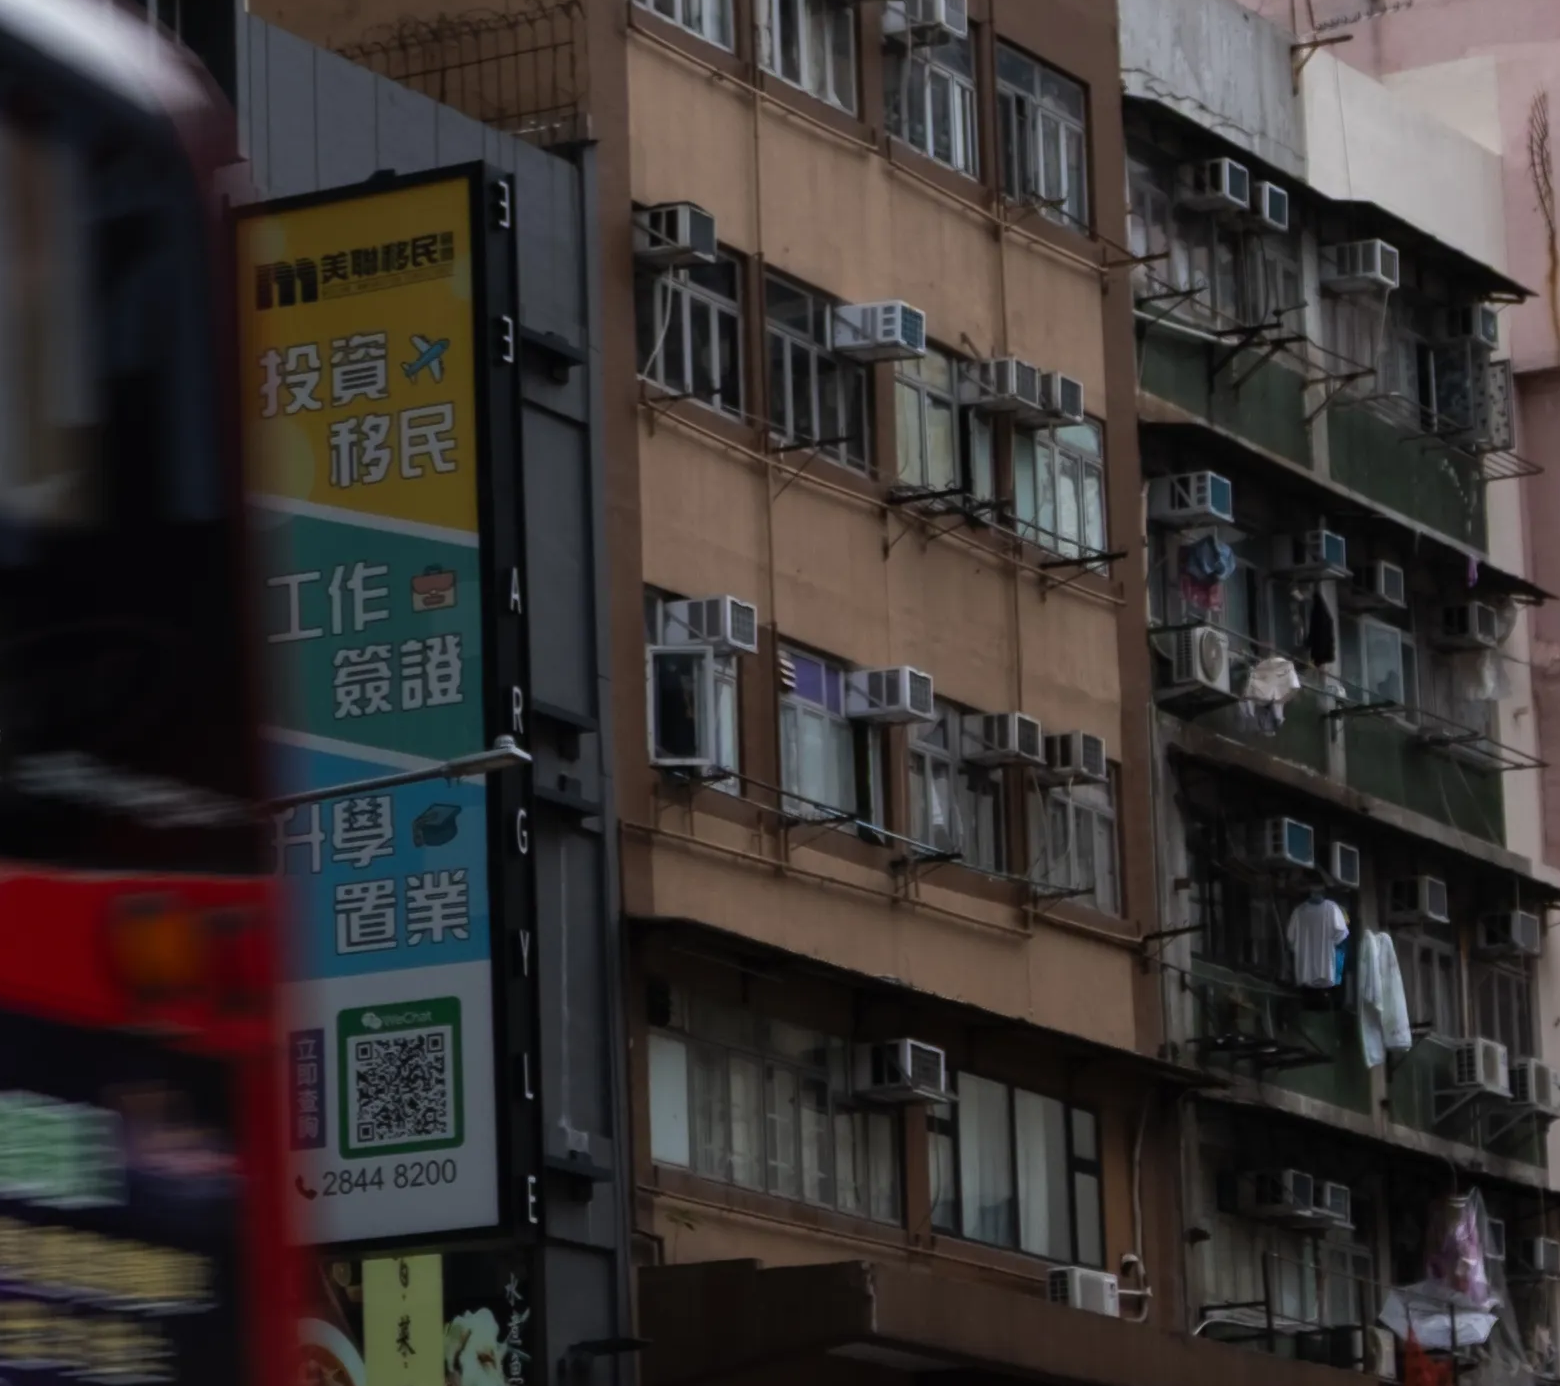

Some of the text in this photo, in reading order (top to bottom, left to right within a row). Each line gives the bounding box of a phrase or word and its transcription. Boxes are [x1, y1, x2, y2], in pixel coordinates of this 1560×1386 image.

[259, 330, 391, 421] 投資
[329, 400, 460, 490] 移民
[265, 561, 391, 646] 工作
[333, 632, 465, 721] 簽證
[333, 867, 472, 958] 置業
[381, 1009, 435, 1027] WeChat
[322, 1158, 458, 1199] 2844 8200
